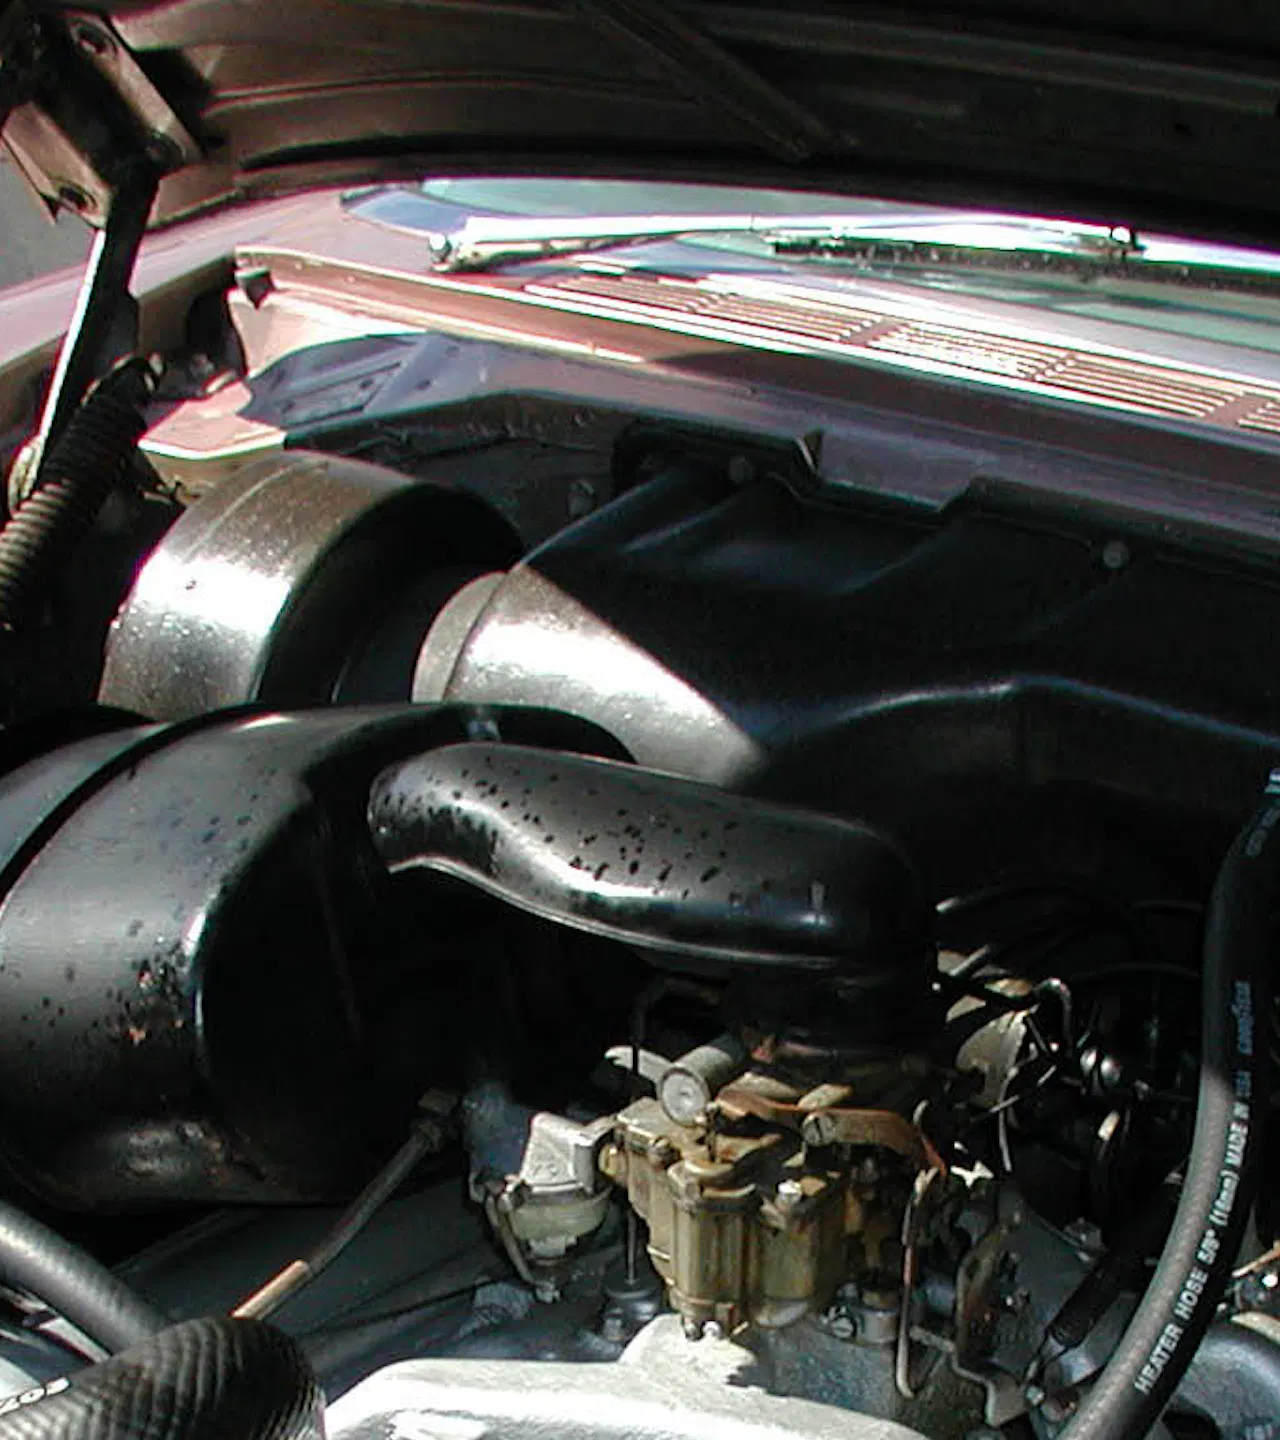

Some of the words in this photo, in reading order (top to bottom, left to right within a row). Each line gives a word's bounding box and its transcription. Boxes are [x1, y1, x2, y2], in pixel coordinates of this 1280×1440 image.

[1233, 1102, 1250, 1120] IN
[1225, 1122, 1248, 1168] MADE
[1175, 1268, 1209, 1322] HOSE
[1135, 1325, 1183, 1396] HEATER
